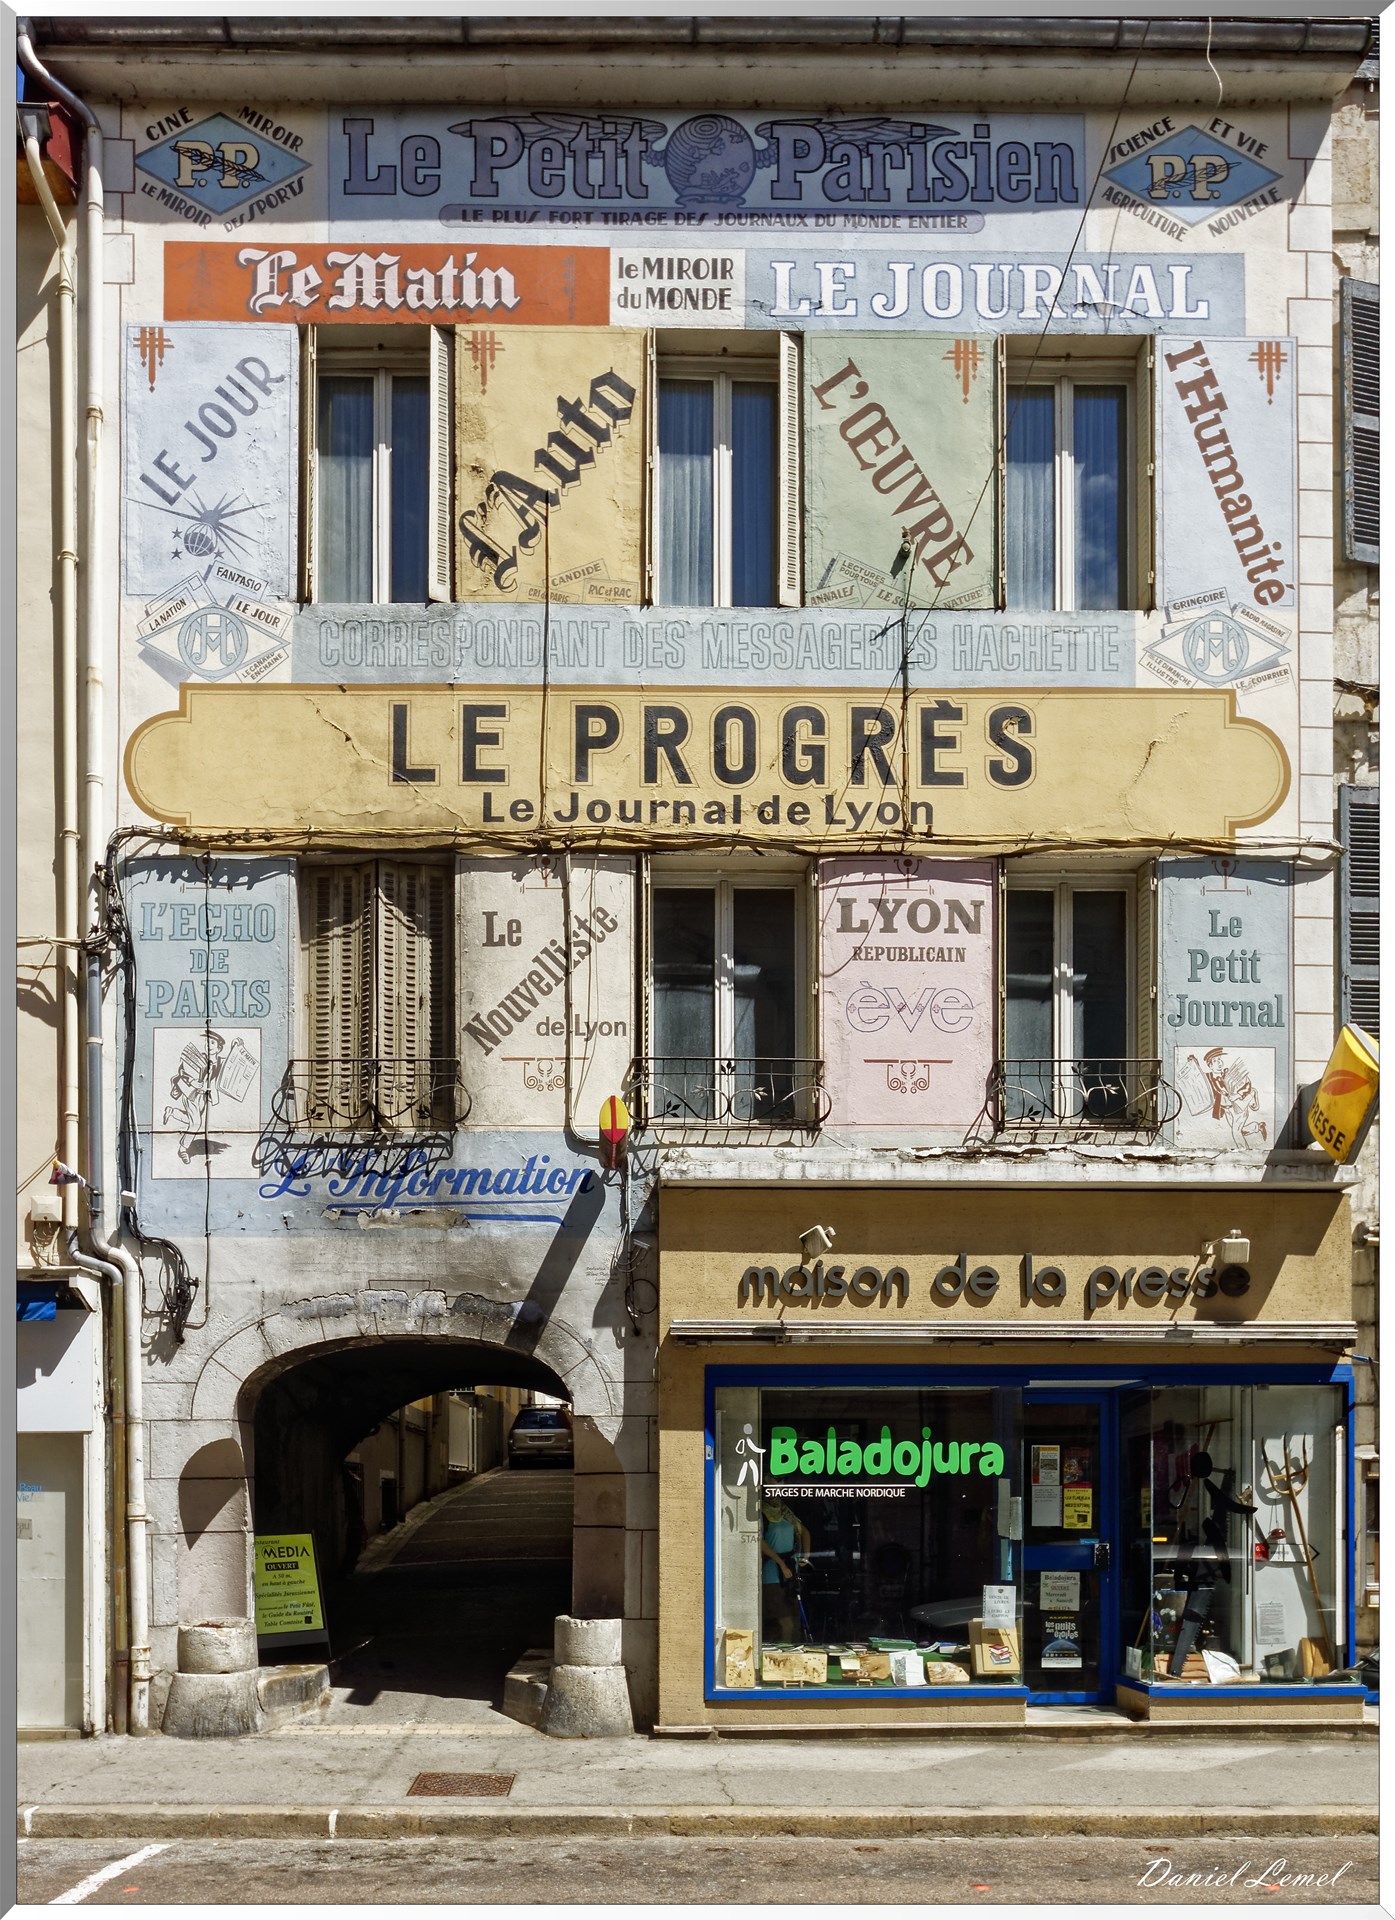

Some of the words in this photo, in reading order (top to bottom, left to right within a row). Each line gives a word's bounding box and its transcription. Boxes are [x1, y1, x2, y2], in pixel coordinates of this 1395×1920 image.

[146, 106, 194, 141] CINE
[238, 105, 304, 152] MIROIR
[1109, 116, 1176, 164] SCIENCE
[1209, 117, 1234, 139] ET
[1236, 132, 1269, 160] VIE
[343, 118, 440, 197] Le
[470, 119, 652, 200] Petit
[769, 121, 1081, 204] Parisien
[141, 182, 156, 197] LE
[156, 188, 212, 230] MIROIR
[223, 213, 246, 233] DES
[248, 176, 304, 222] SPORTS
[1101, 186, 1188, 242] AGRICULTURE
[1207, 187, 1282, 237] NOUVELLE
[461, 209, 484, 223] LE
[493, 210, 541, 225] PLUS
[549, 211, 594, 225] FORT
[601, 211, 667, 226] TIRAGE
[674, 211, 708, 227] DES
[714, 212, 809, 228] JOURNAUX
[815, 213, 837, 229] DU
[842, 213, 901, 230] MONDE
[908, 214, 969, 230] ENTIER
[237, 247, 321, 316] Le
[324, 250, 522, 315] Matin
[618, 257, 639, 279] le
[641, 257, 735, 281] MIROIR
[617, 288, 643, 311] du
[645, 287, 732, 312] MONDE
[770, 260, 858, 318] LE
[870, 262, 1210, 320] JOURNAL
[139, 449, 198, 507] LE
[184, 356, 287, 463] JOUR
[459, 367, 637, 594] L'Auto
[810, 357, 975, 589] L'ŒUVRE
[216, 566, 262, 593] FANTASIO
[551, 563, 601, 587] CANDIDE
[839, 567, 860, 583] POUR
[859, 576, 879, 588] TOUS
[842, 560, 885, 584] LECTURES
[529, 588, 541, 597] CRI
[550, 592, 569, 603] PARIS
[614, 588, 631, 598] RAC
[811, 585, 855, 606] ANNALES
[877, 589, 892, 602] LE
[943, 590, 983, 608] NATURE
[1173, 591, 1226, 611] GRINGOIRE
[148, 613, 162, 632] LA
[160, 598, 187, 623] NATION
[236, 601, 250, 614] LE
[250, 607, 281, 628] JOUR
[1240, 608, 1260, 623] RADIO
[318, 619, 610, 668] CORRESPONDANT
[623, 621, 686, 669] DES
[701, 622, 937, 671] MESSAGERIES
[952, 623, 1119, 672] HACHETTE
[242, 669, 251, 678] LE
[250, 653, 283, 680] ENCHAINE
[1154, 658, 1163, 666] LE
[1161, 662, 1192, 686] DIMANCHE
[1235, 680, 1246, 690] LE
[1251, 668, 1290, 685] COURRIER
[390, 702, 508, 784] LE
[572, 698, 1035, 788] PROGRÈS
[483, 792, 534, 823] Le
[553, 792, 742, 825] Journal
[758, 795, 811, 825] de
[826, 795, 934, 832] Lyon
[140, 902, 276, 943] L'ECHO
[482, 911, 522, 947] Le
[836, 898, 985, 934] LYON
[1208, 909, 1243, 938] Le
[189, 949, 230, 974] DE
[852, 946, 967, 963] REPUBLICAIN
[1187, 949, 1261, 984] Petit
[462, 906, 619, 1056] Nouvelliste
[144, 980, 271, 1019] PARIS
[846, 981, 974, 1033] ève
[1168, 994, 1285, 1028] Journal
[536, 1016, 565, 1037] de
[574, 1014, 627, 1042] Lyon
[741, 1260, 909, 1297] maison
[935, 1252, 1000, 1298] de
[1025, 1252, 1066, 1298] la
[1090, 1264, 1251, 1310] presse
[770, 1425, 1004, 1488] Baladojura
[765, 1488, 799, 1498] STAGES
[800, 1488, 813, 1498] DE
[815, 1488, 854, 1498] MARCHE
[856, 1488, 906, 1499] NORDIQUE
[262, 1546, 310, 1559] MEDIA
[267, 1562, 297, 1570] OUVERT
[1055, 1621, 1076, 1631] nuits
